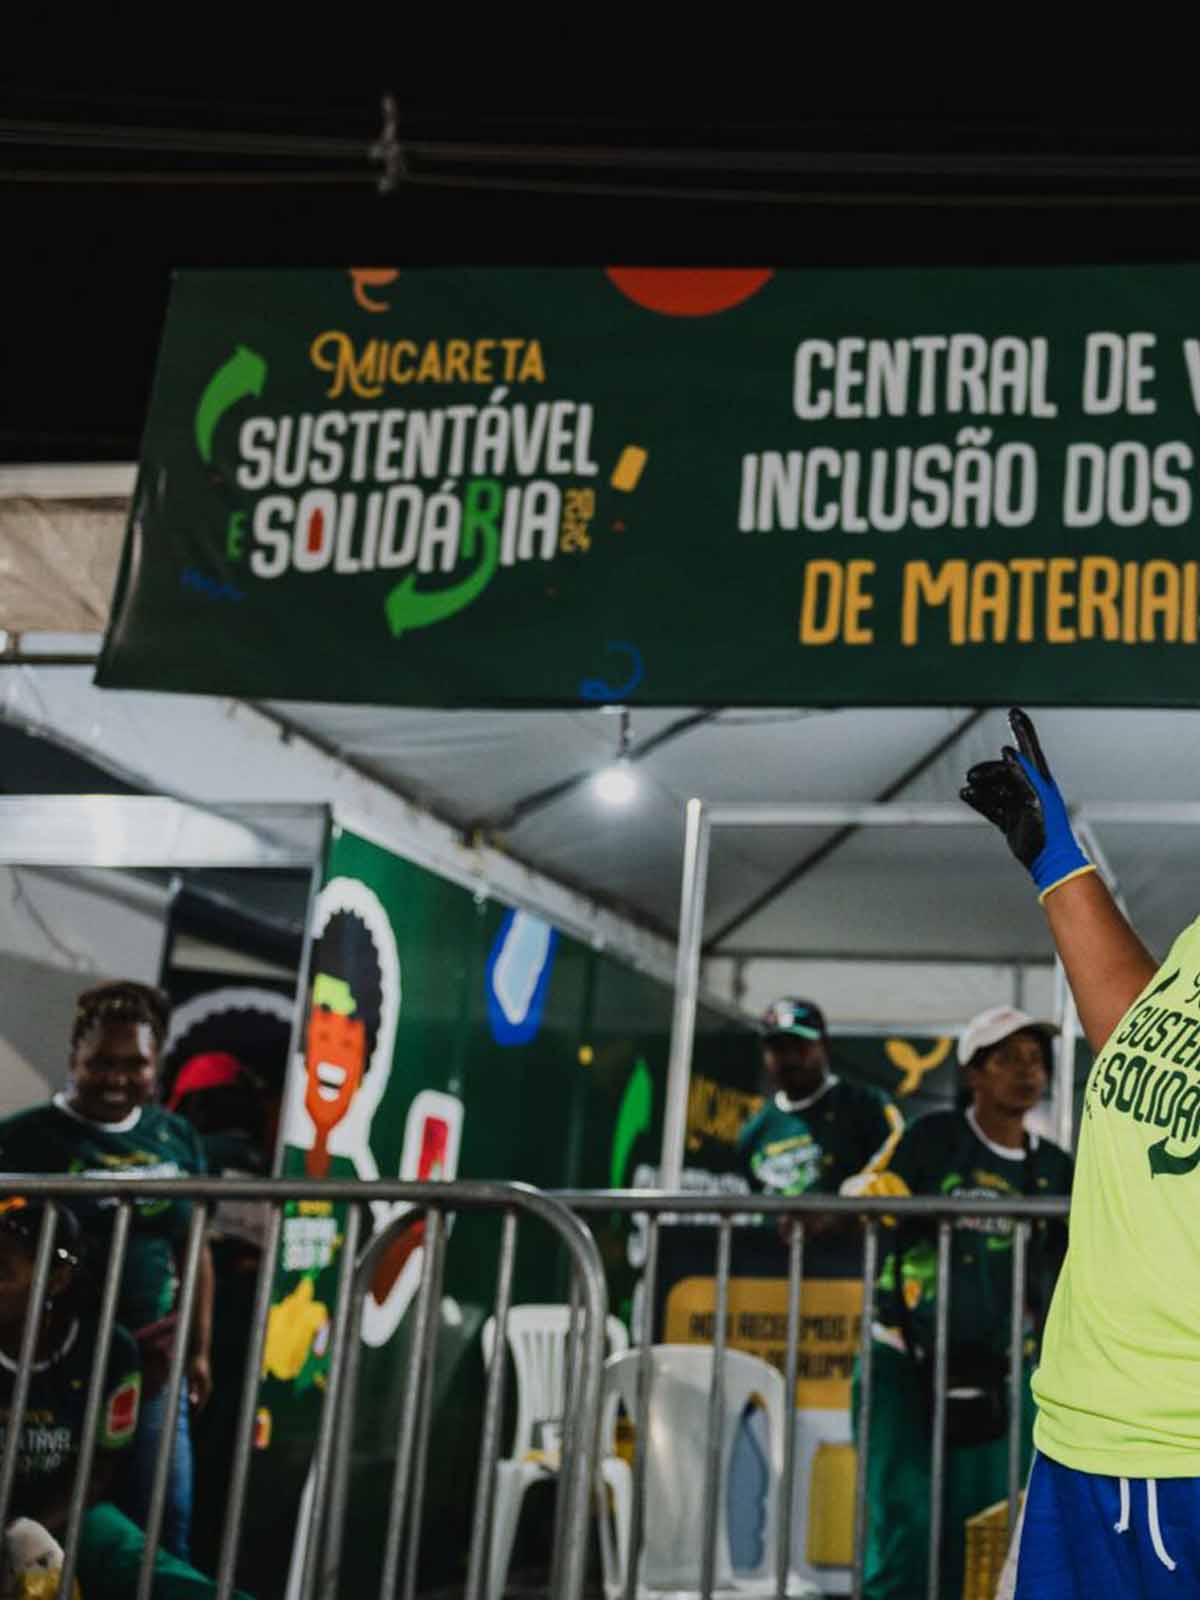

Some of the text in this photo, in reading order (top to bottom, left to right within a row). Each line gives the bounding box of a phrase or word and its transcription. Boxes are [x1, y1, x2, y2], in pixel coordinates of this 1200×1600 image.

[310, 331, 546, 398] MICARETA
[793, 334, 1057, 420] CENTRAL
[1082, 332, 1157, 416] DE
[237, 387, 599, 490] SUSTENTÁVEL
[738, 426, 1038, 533] INCLUSÃO
[1063, 441, 1194, 528] DOS
[251, 480, 561, 578] SOLIDÁRIA
[801, 559, 876, 645] DE
